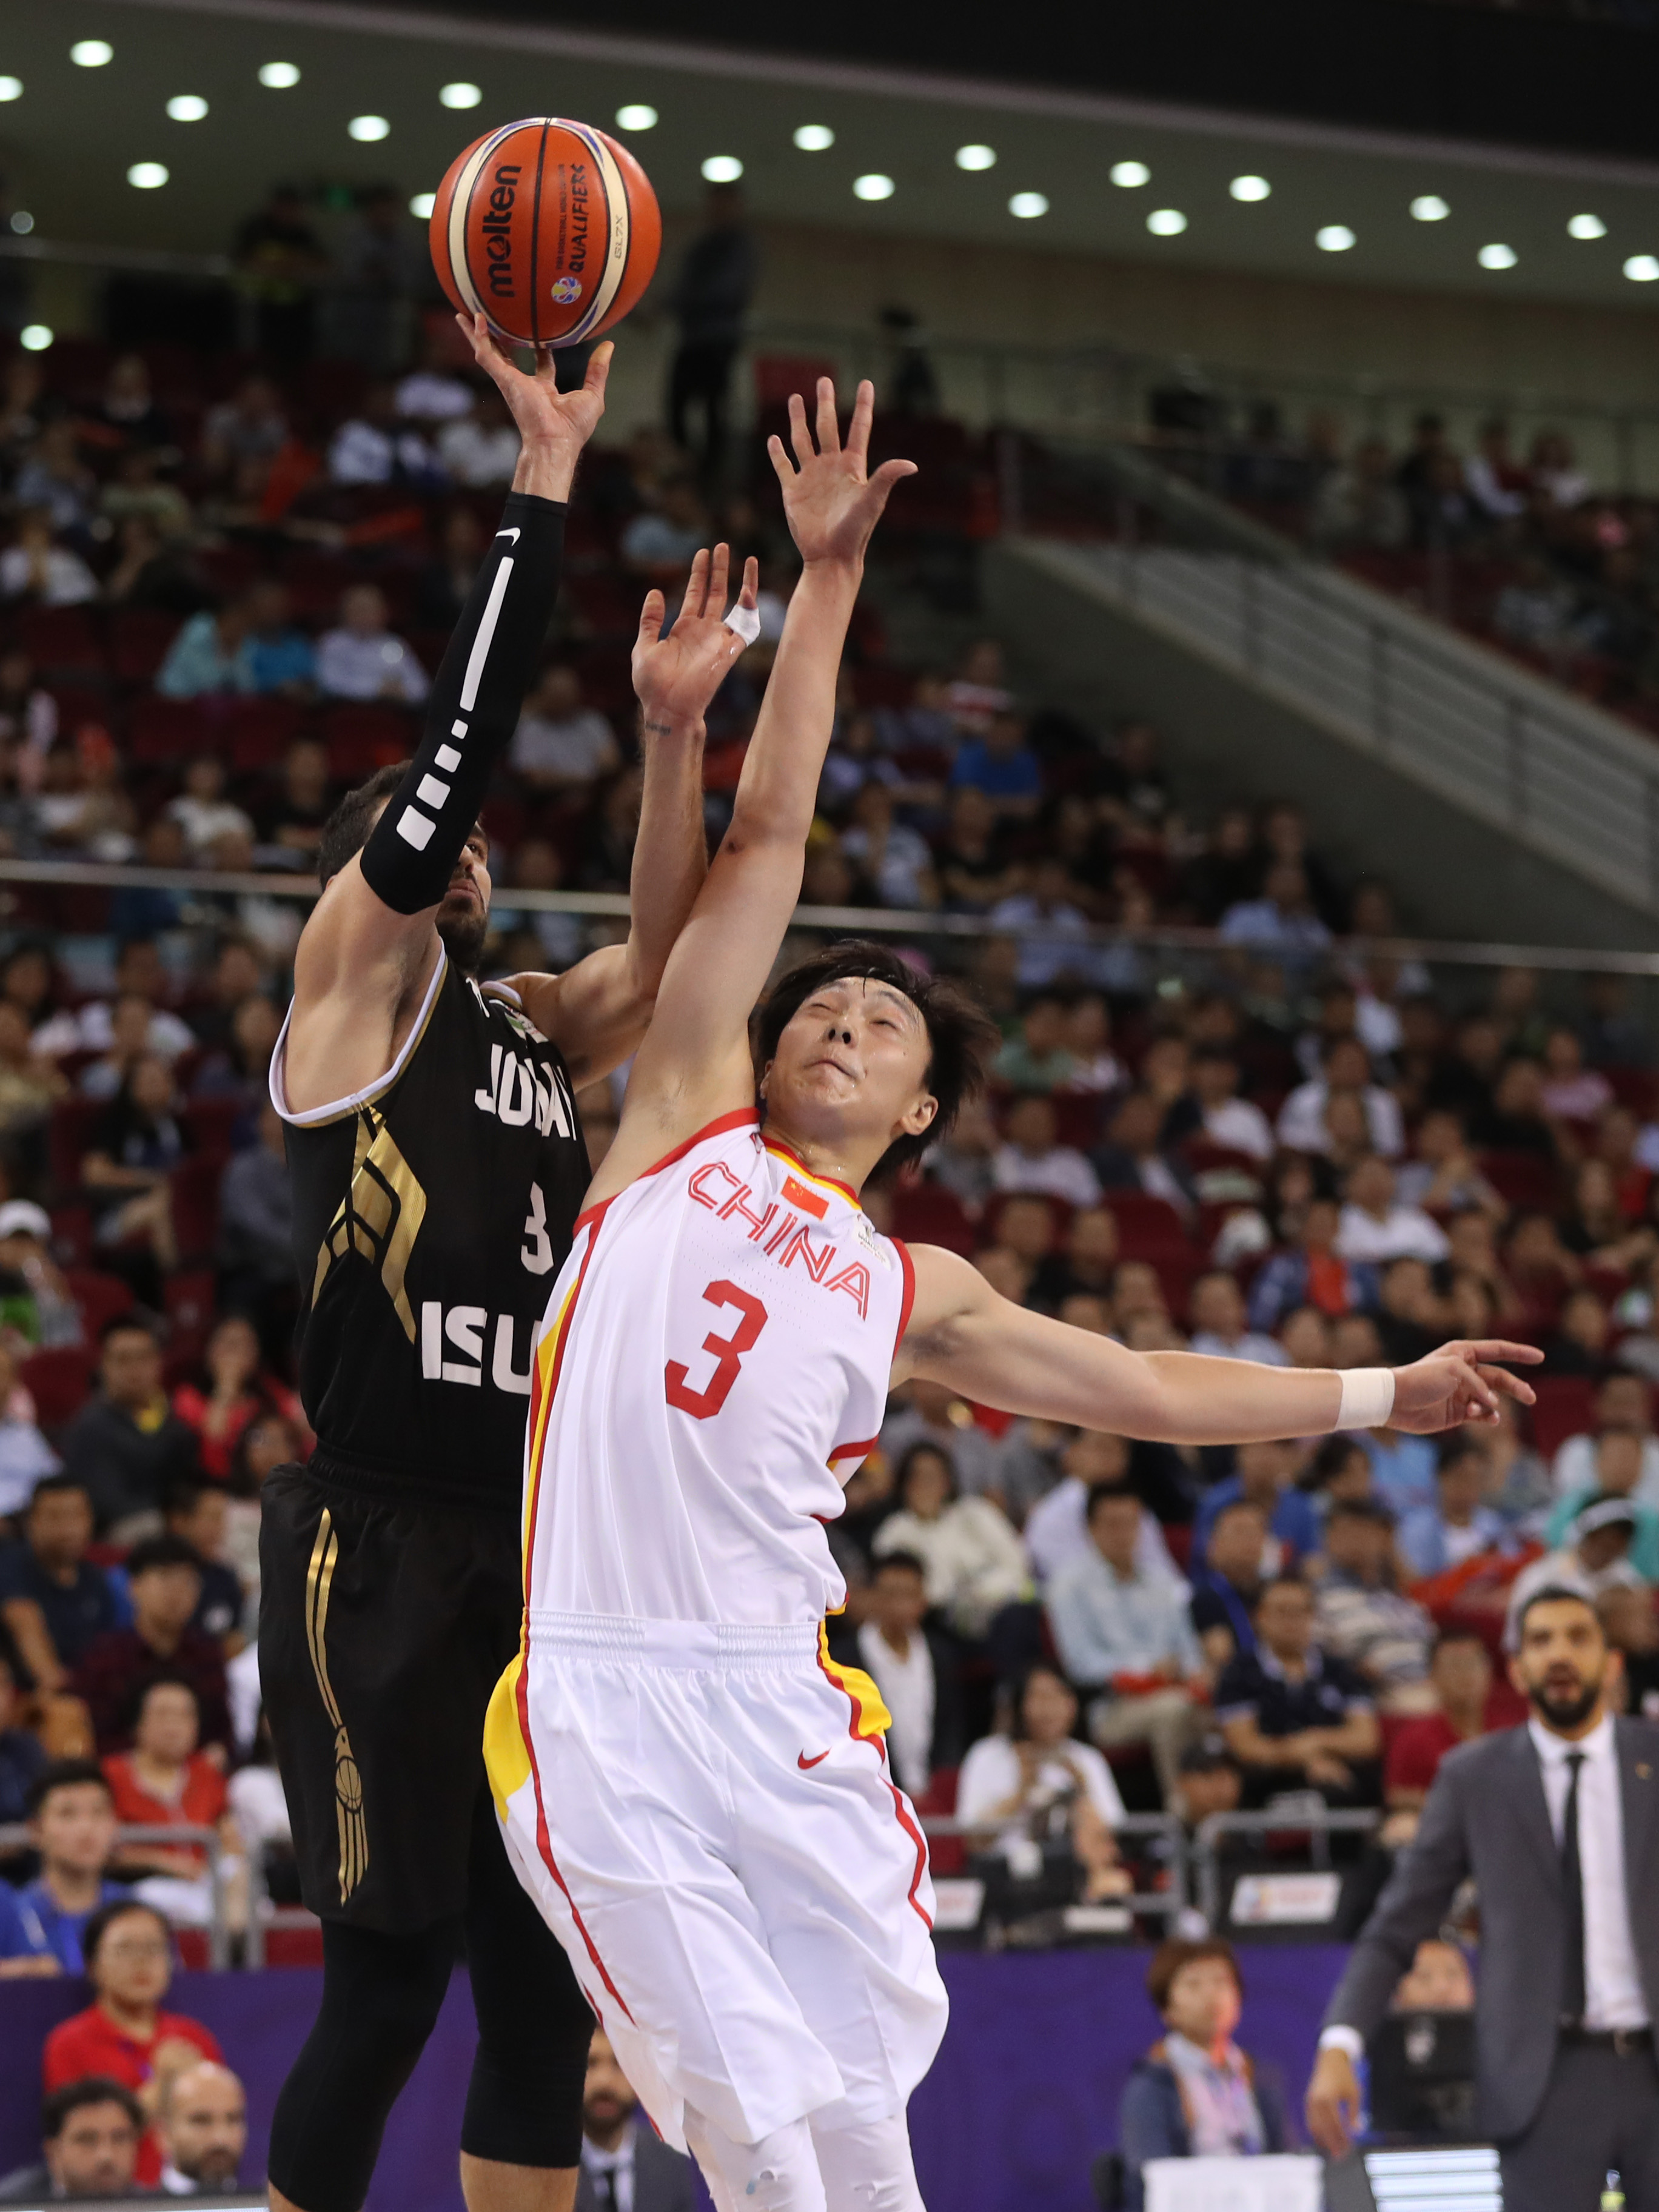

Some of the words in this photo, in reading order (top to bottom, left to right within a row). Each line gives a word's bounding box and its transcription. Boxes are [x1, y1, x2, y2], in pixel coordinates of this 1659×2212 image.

[482, 166, 522, 298] molten
[569, 163, 588, 273] QUALIFIERS
[520, 1181, 554, 1275] 3
[688, 1161, 870, 1321] CHINA
[665, 1279, 768, 1419] 3
